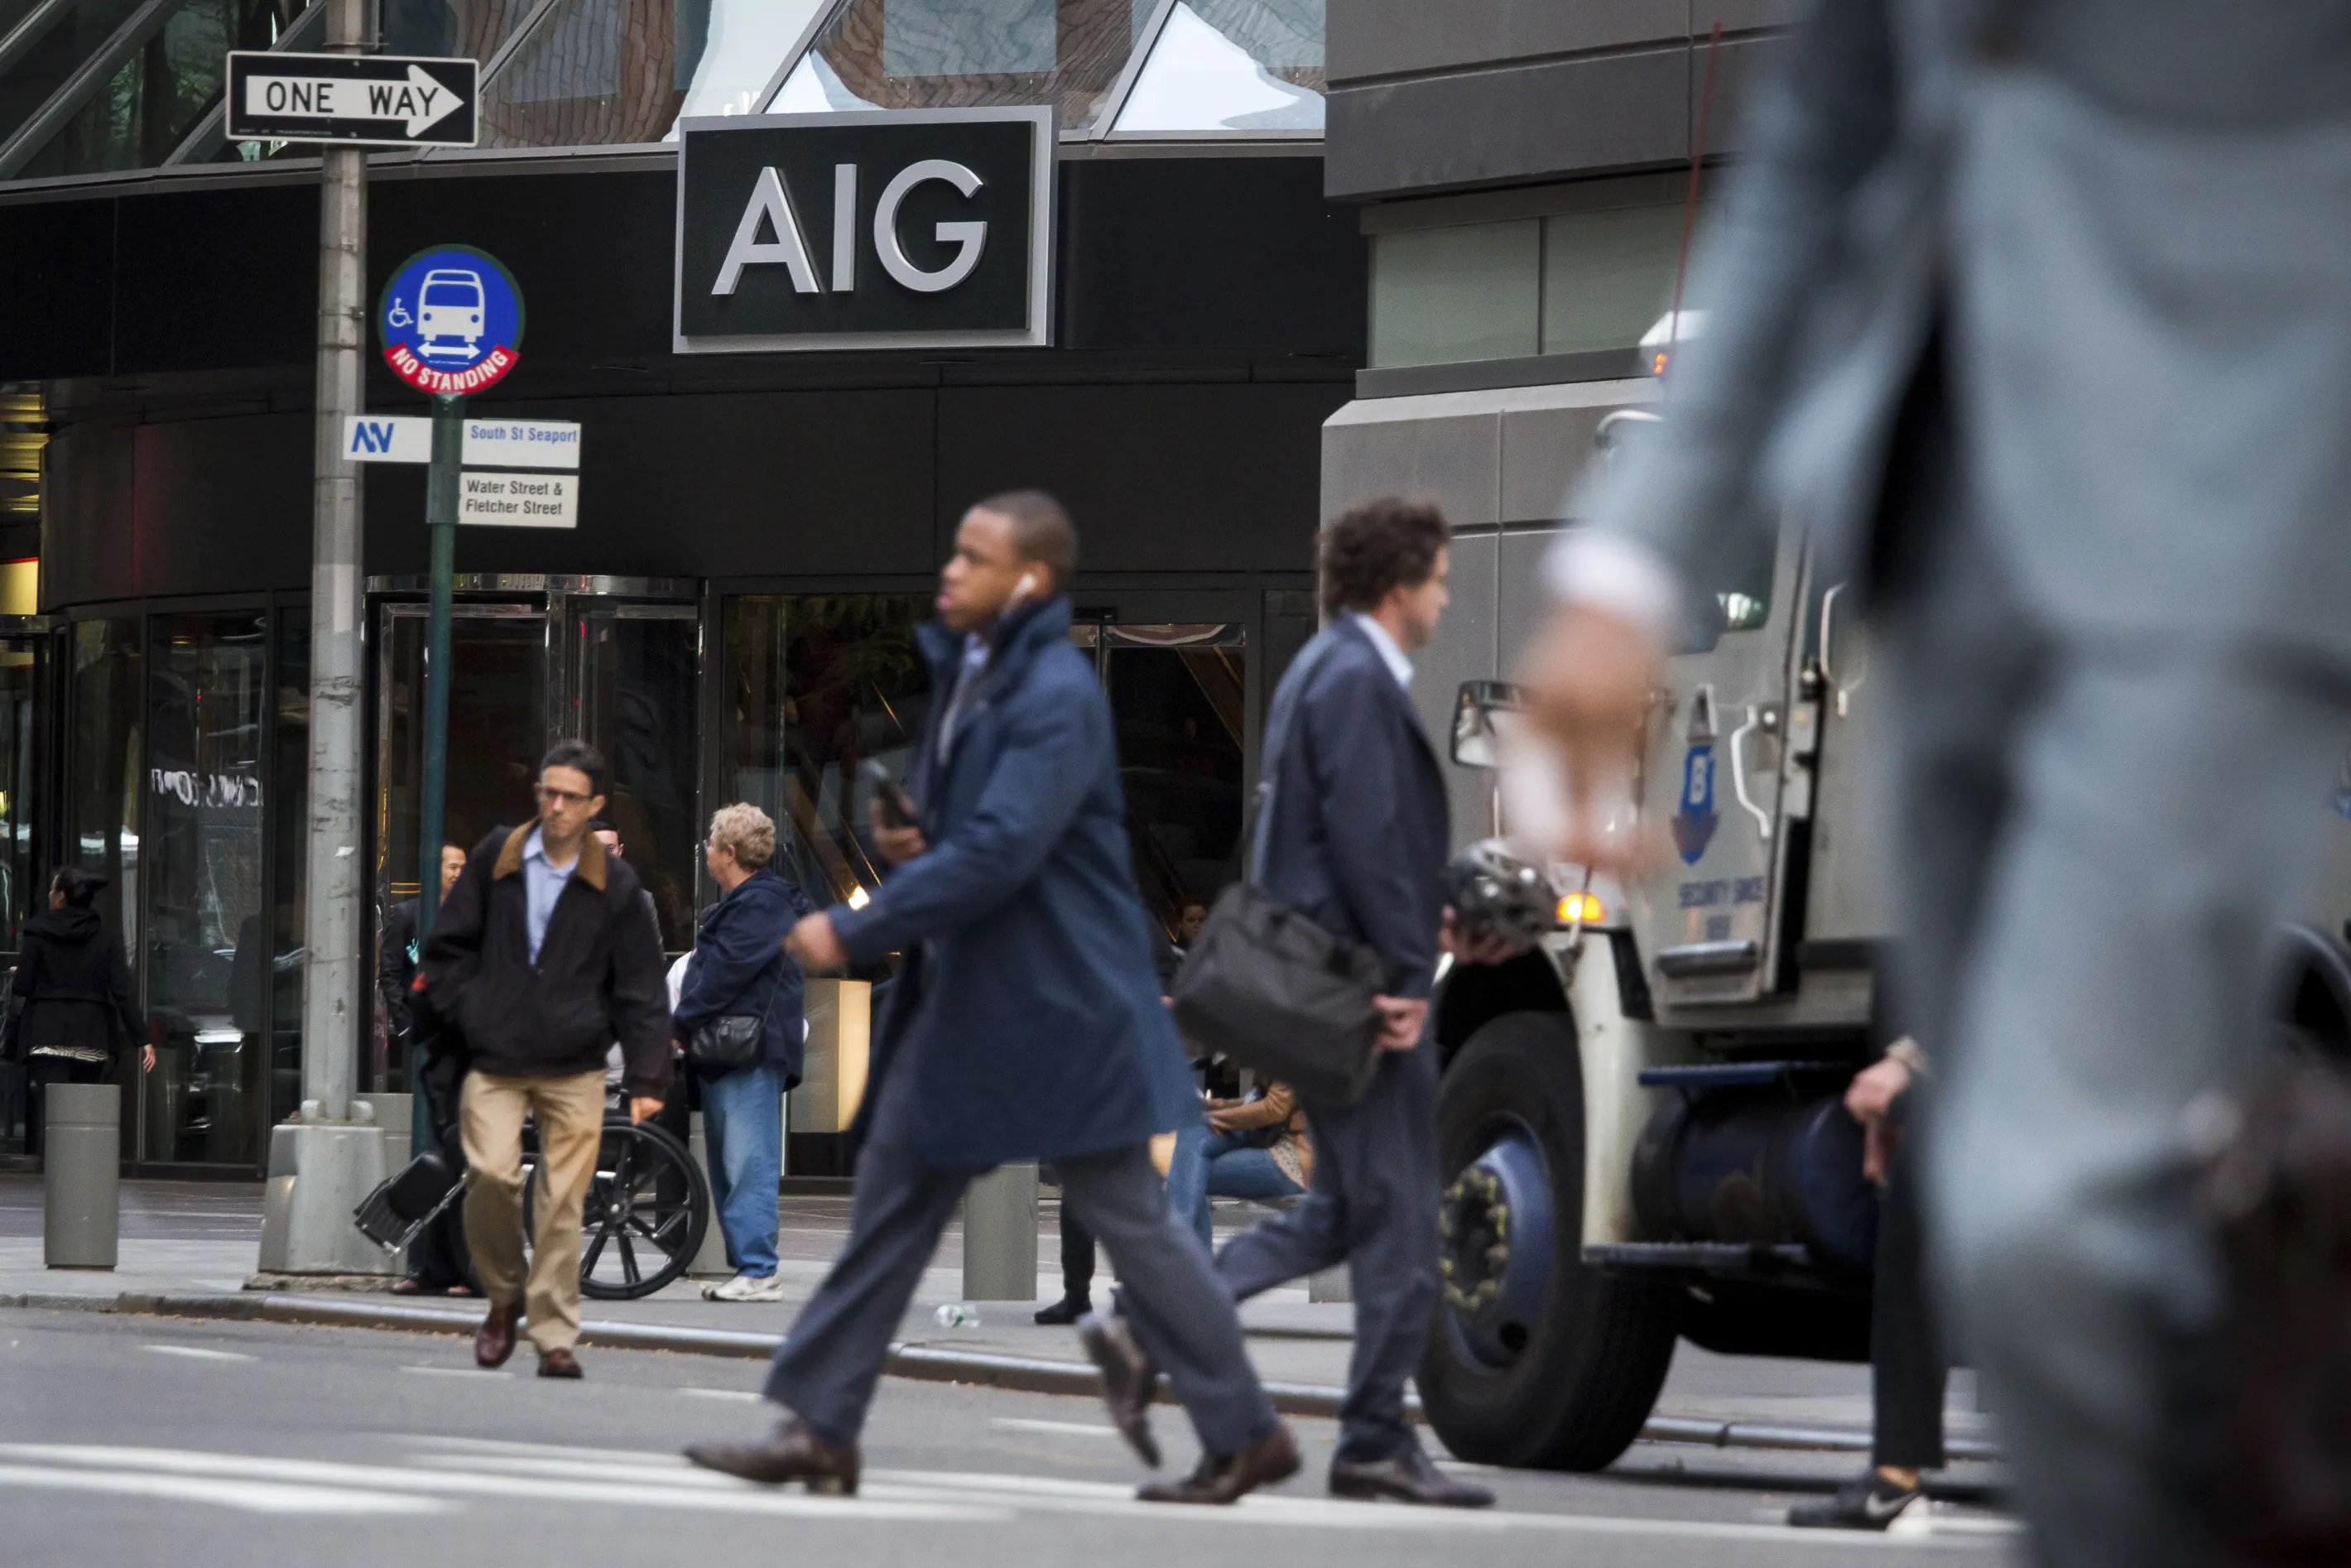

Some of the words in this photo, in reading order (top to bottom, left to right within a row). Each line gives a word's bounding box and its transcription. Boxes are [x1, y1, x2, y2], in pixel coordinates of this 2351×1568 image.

[266, 81, 334, 113] ONE
[368, 85, 440, 117] WAY
[711, 159, 988, 295] AIG
[392, 348, 419, 375] NO
[417, 350, 509, 391] STANDING
[471, 425, 507, 440] South
[511, 426, 524, 440] St
[528, 427, 578, 445] Seaport
[466, 479, 506, 494] Water
[510, 480, 549, 495] Street
[553, 482, 563, 496] &
[465, 498, 519, 513] Fletcher
[523, 500, 563, 515] Street
